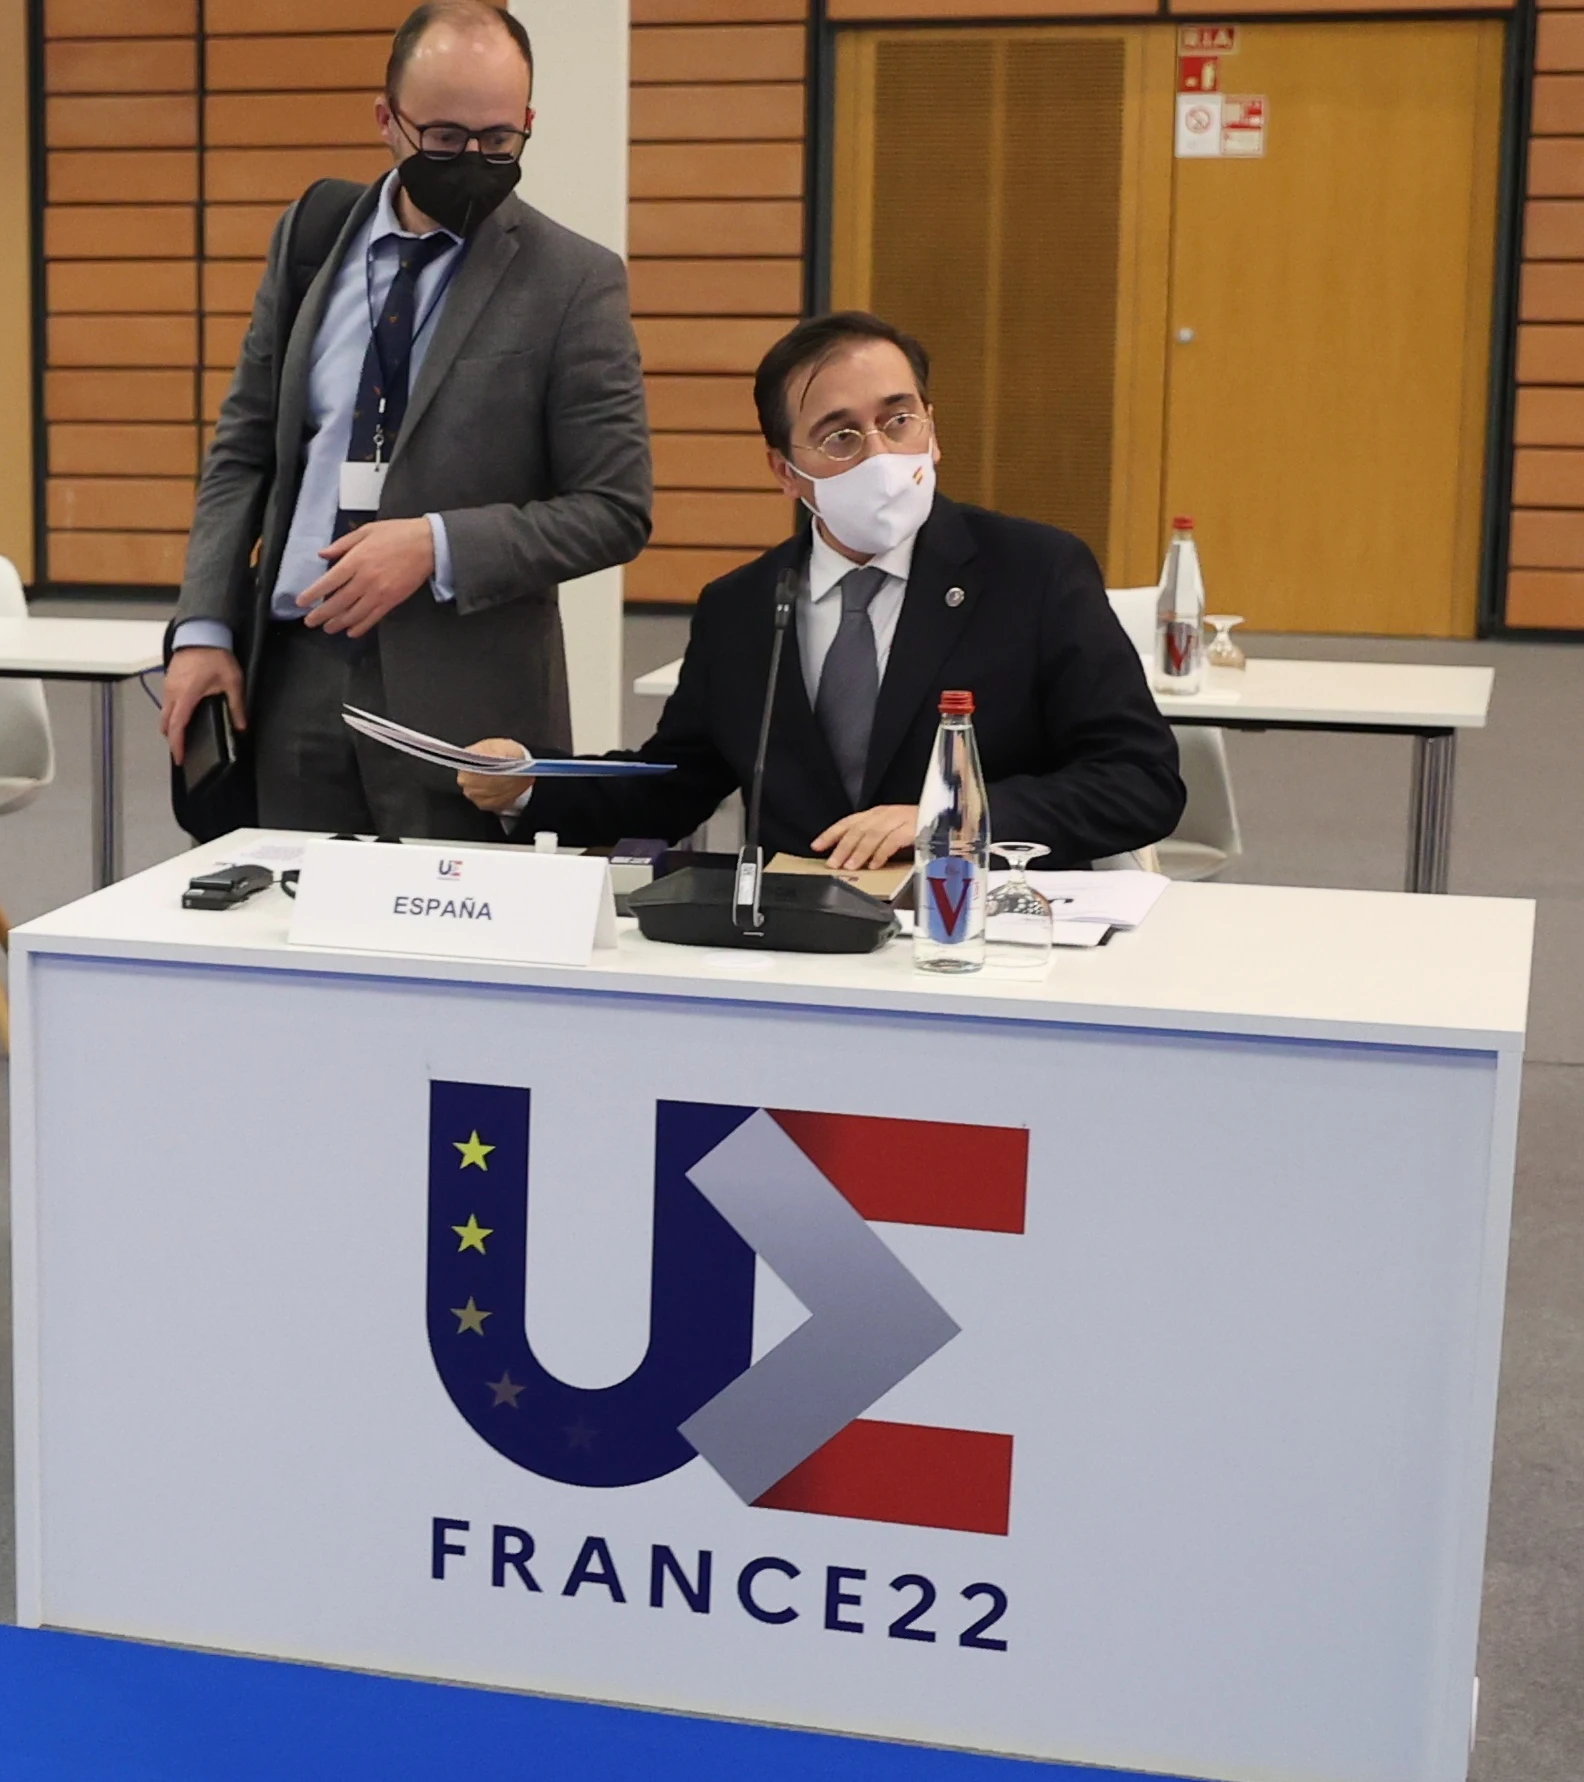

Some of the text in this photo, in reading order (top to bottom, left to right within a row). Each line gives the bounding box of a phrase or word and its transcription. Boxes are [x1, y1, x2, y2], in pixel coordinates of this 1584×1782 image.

[393, 896, 492, 921] ESPAÑA
[926, 876, 974, 937] V
[431, 1517, 1009, 1651] FRANCE22
